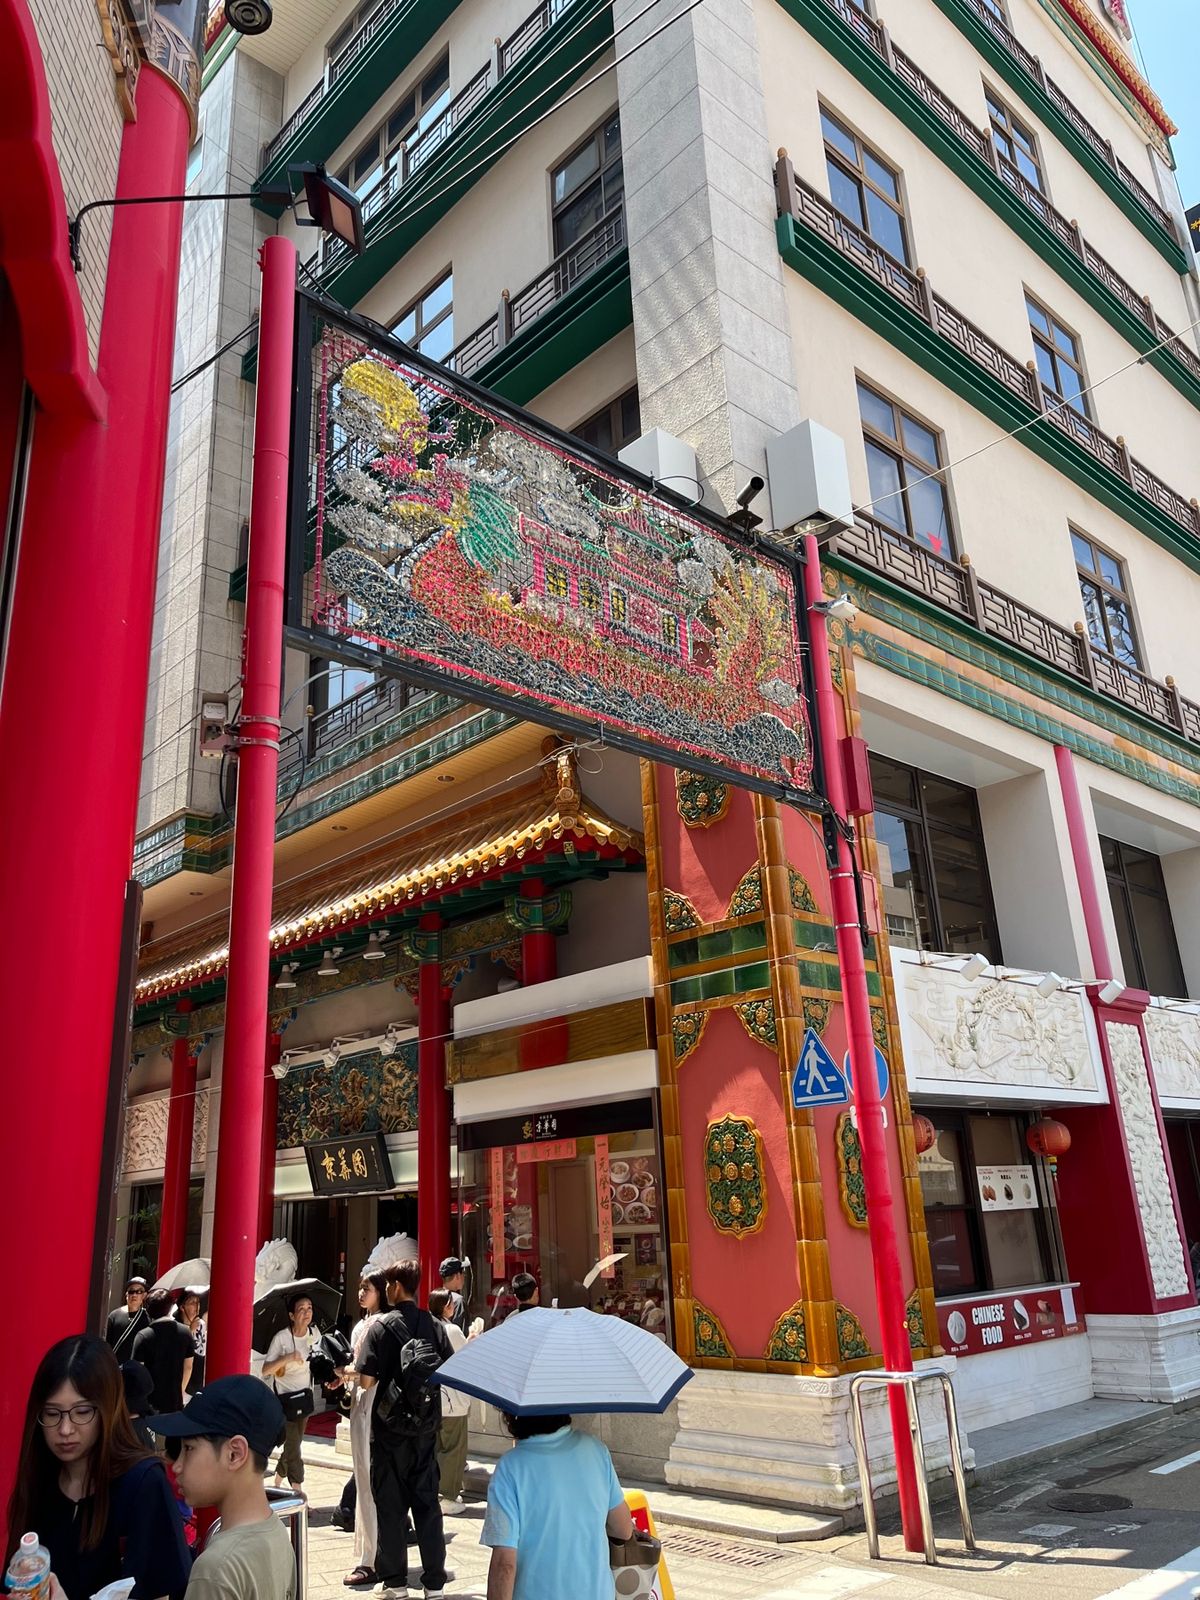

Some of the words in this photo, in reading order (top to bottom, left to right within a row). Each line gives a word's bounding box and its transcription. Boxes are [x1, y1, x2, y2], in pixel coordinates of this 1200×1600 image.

[321, 1147, 367, 1182] 京華園
[972, 1304, 1005, 1325] CHINESE
[982, 1326, 1003, 1345] FOOD
